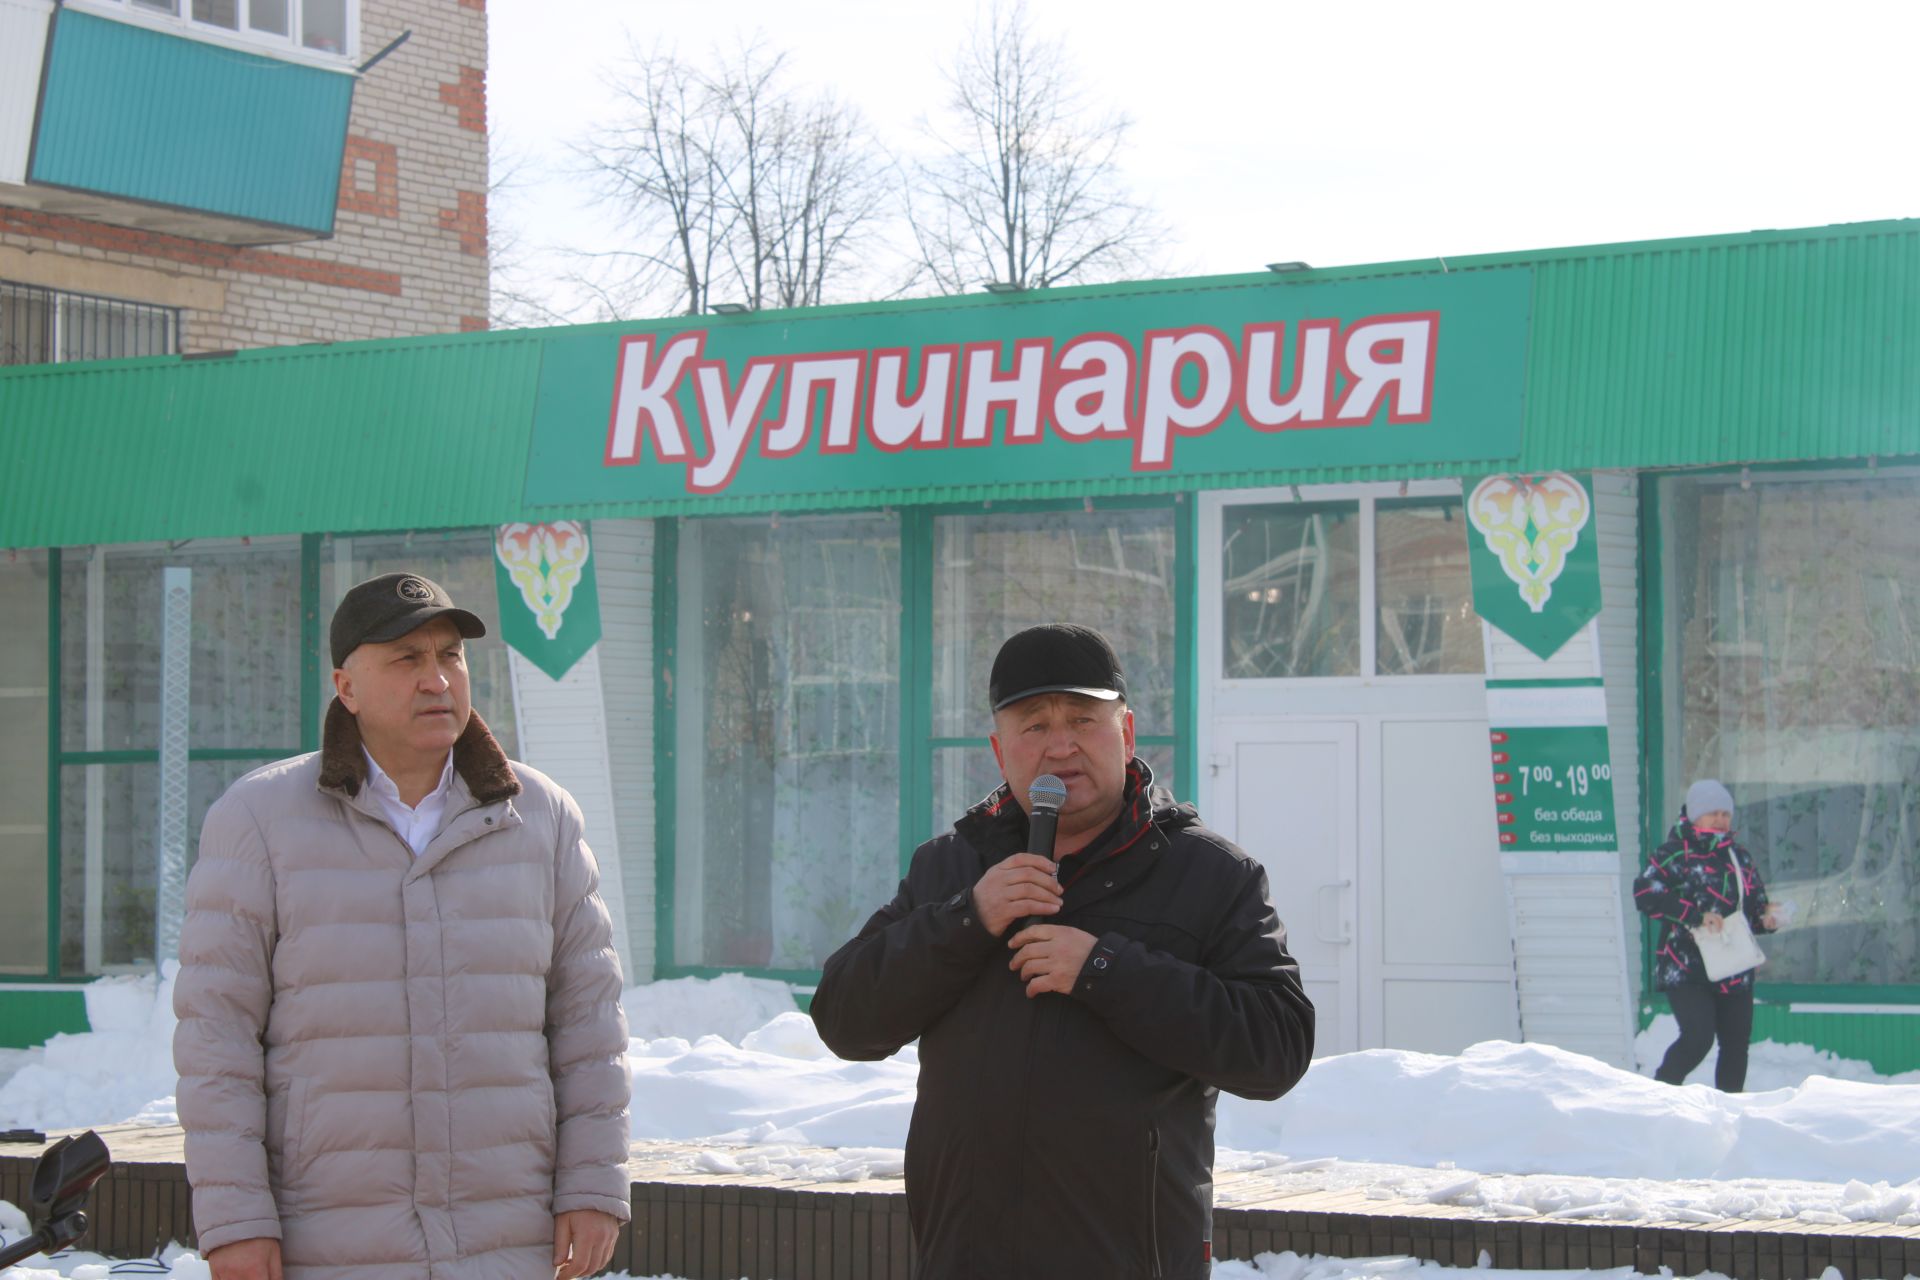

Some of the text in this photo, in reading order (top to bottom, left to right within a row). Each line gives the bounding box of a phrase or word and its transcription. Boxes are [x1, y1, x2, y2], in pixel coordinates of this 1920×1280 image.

[604, 310, 1441, 495] Кулинария
[1534, 806, 1603, 822] без обеда
[1530, 830, 1615, 844] без выходных
